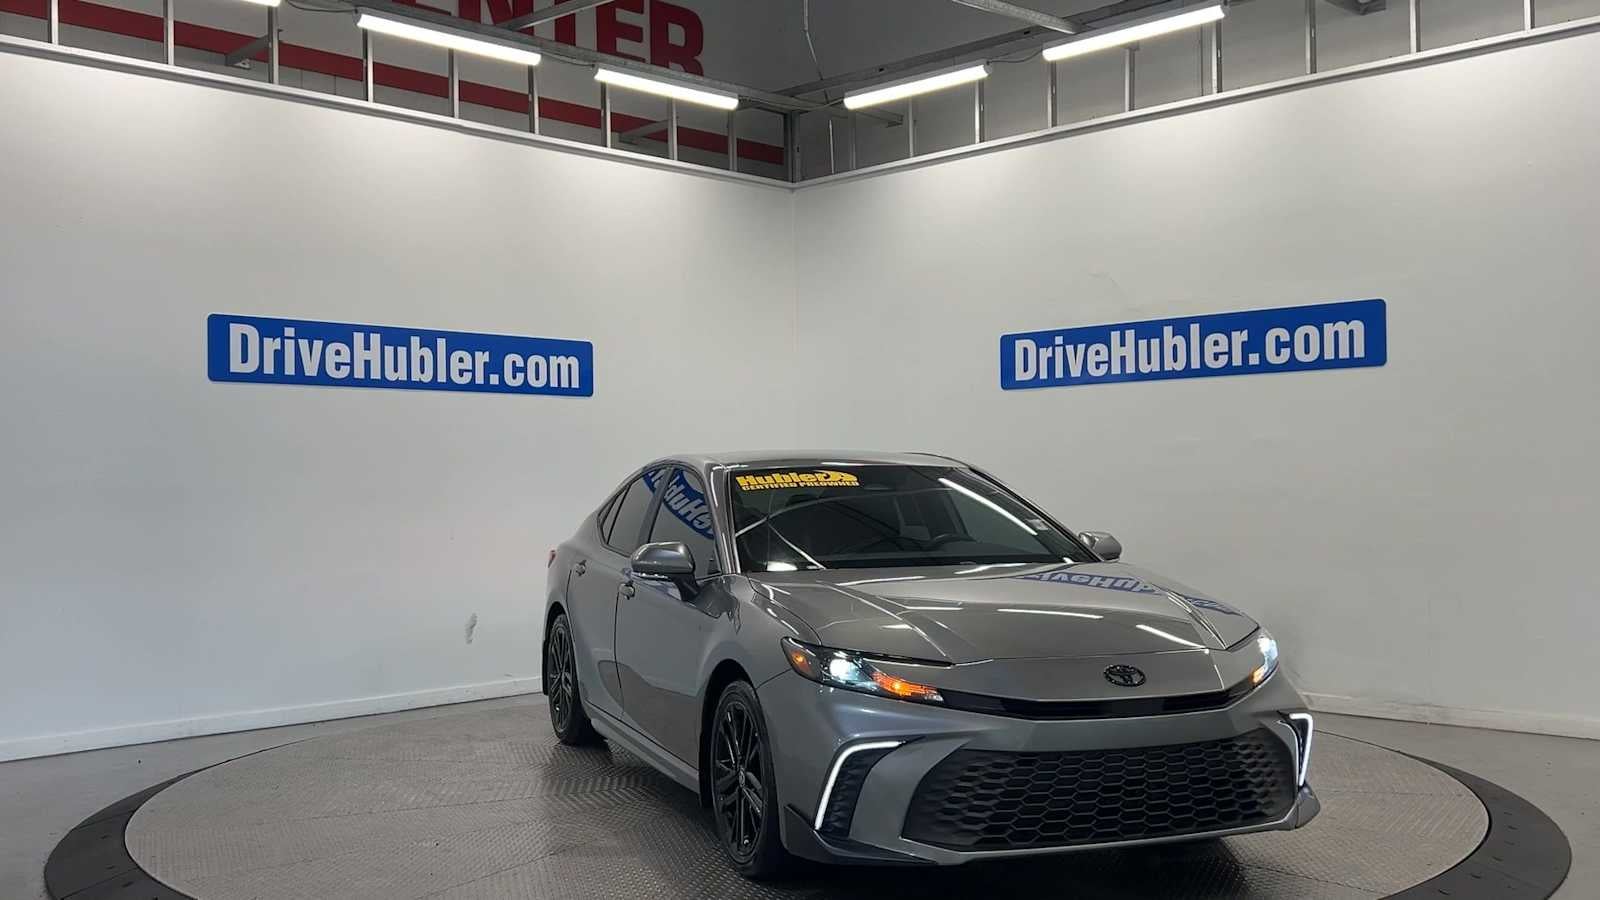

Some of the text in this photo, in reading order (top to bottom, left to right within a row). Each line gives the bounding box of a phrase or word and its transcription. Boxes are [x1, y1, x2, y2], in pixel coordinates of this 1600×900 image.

[229, 322, 580, 389] DriveHubler.com
[1014, 319, 1365, 382] DriveHubler.com
[736, 471, 836, 486] Hubler
